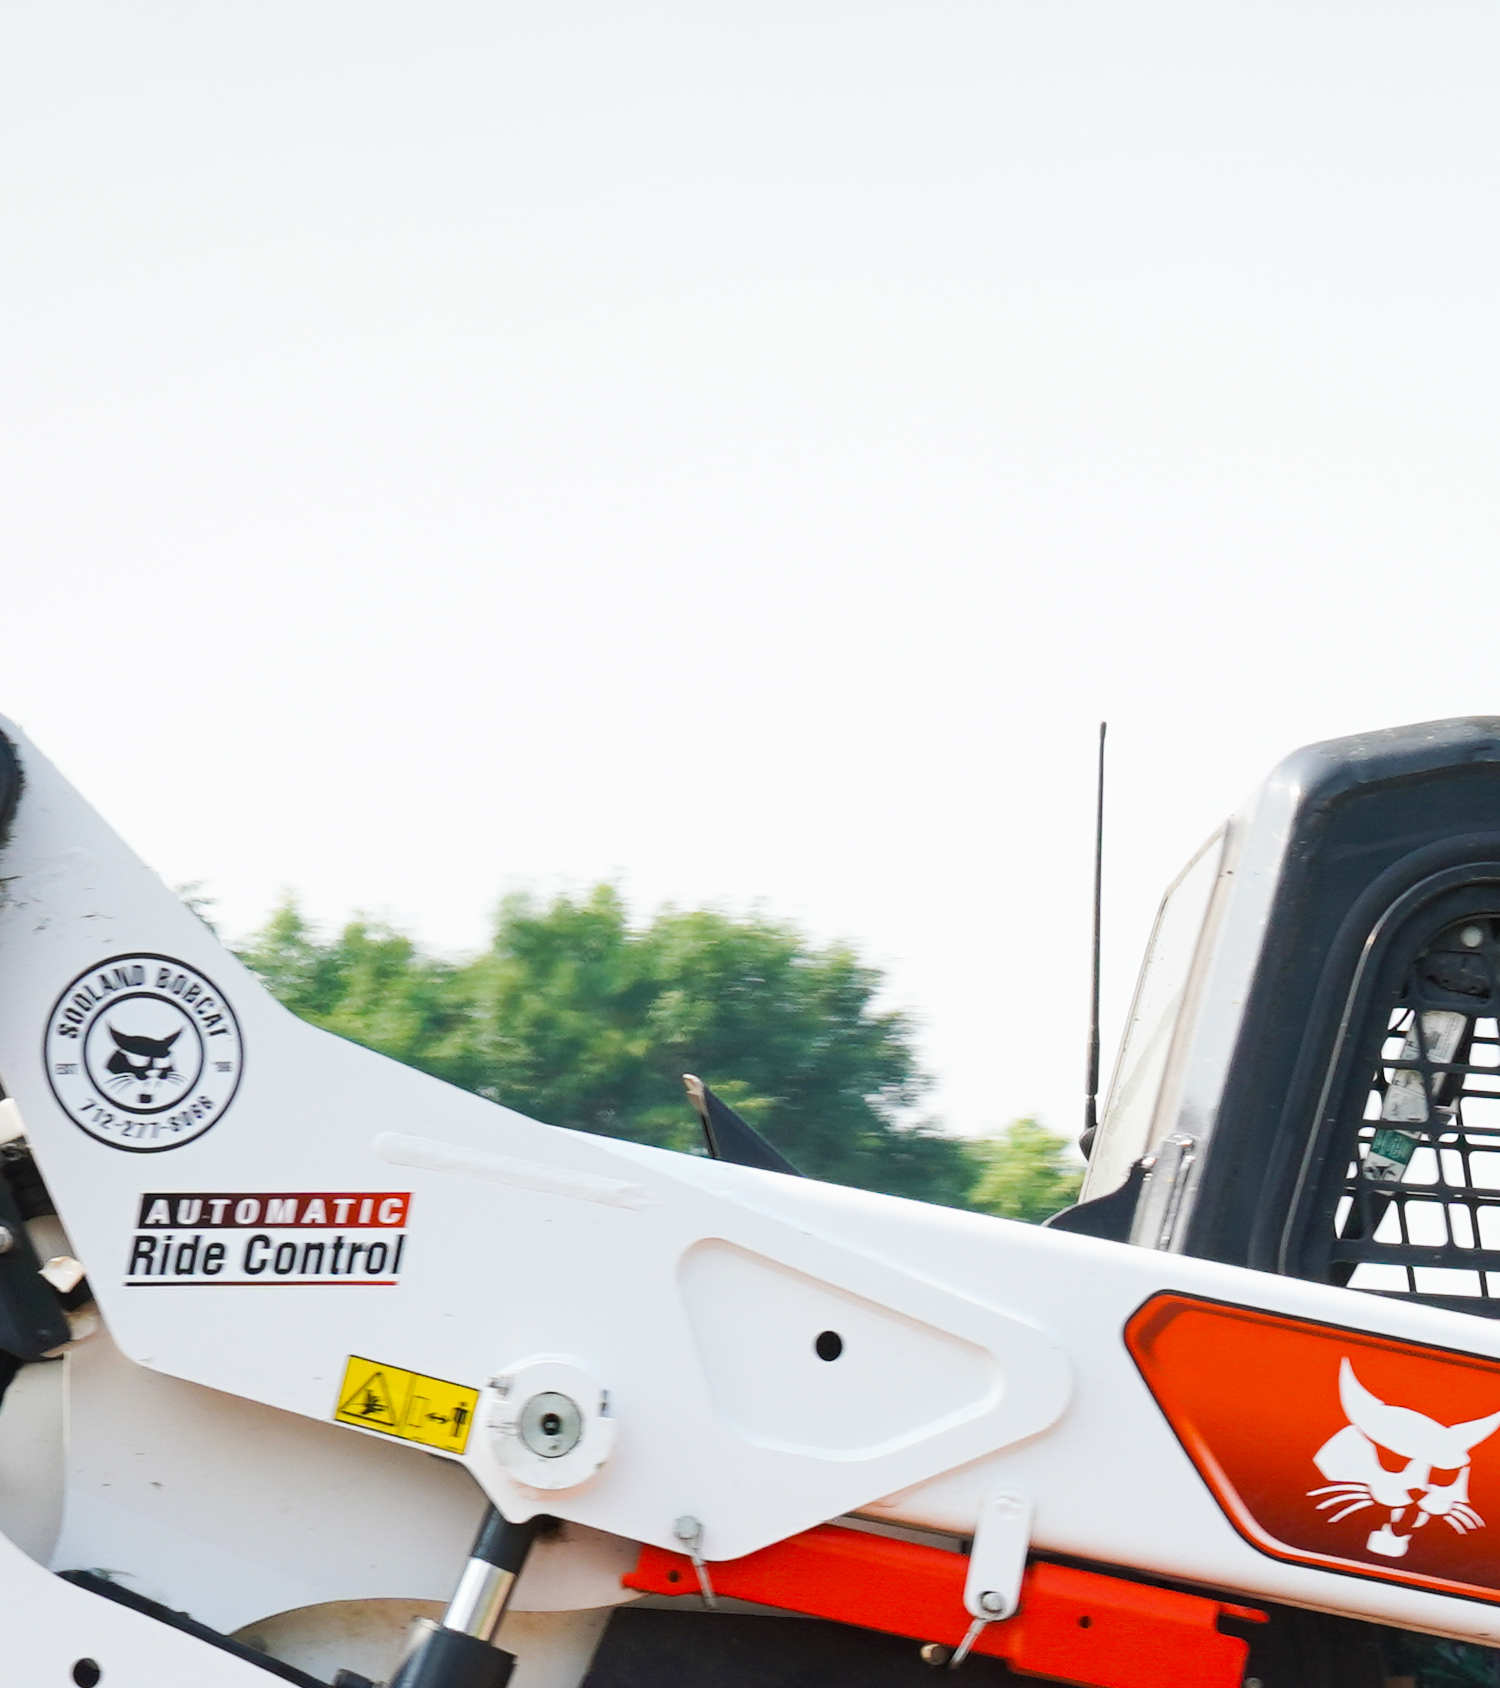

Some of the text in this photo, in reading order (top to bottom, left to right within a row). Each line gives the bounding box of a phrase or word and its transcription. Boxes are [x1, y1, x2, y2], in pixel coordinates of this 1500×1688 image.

[155, 967, 230, 1036] BOBCAT
[143, 1198, 404, 1225] AUTOMATIC
[126, 1234, 407, 1276] Ride Control
